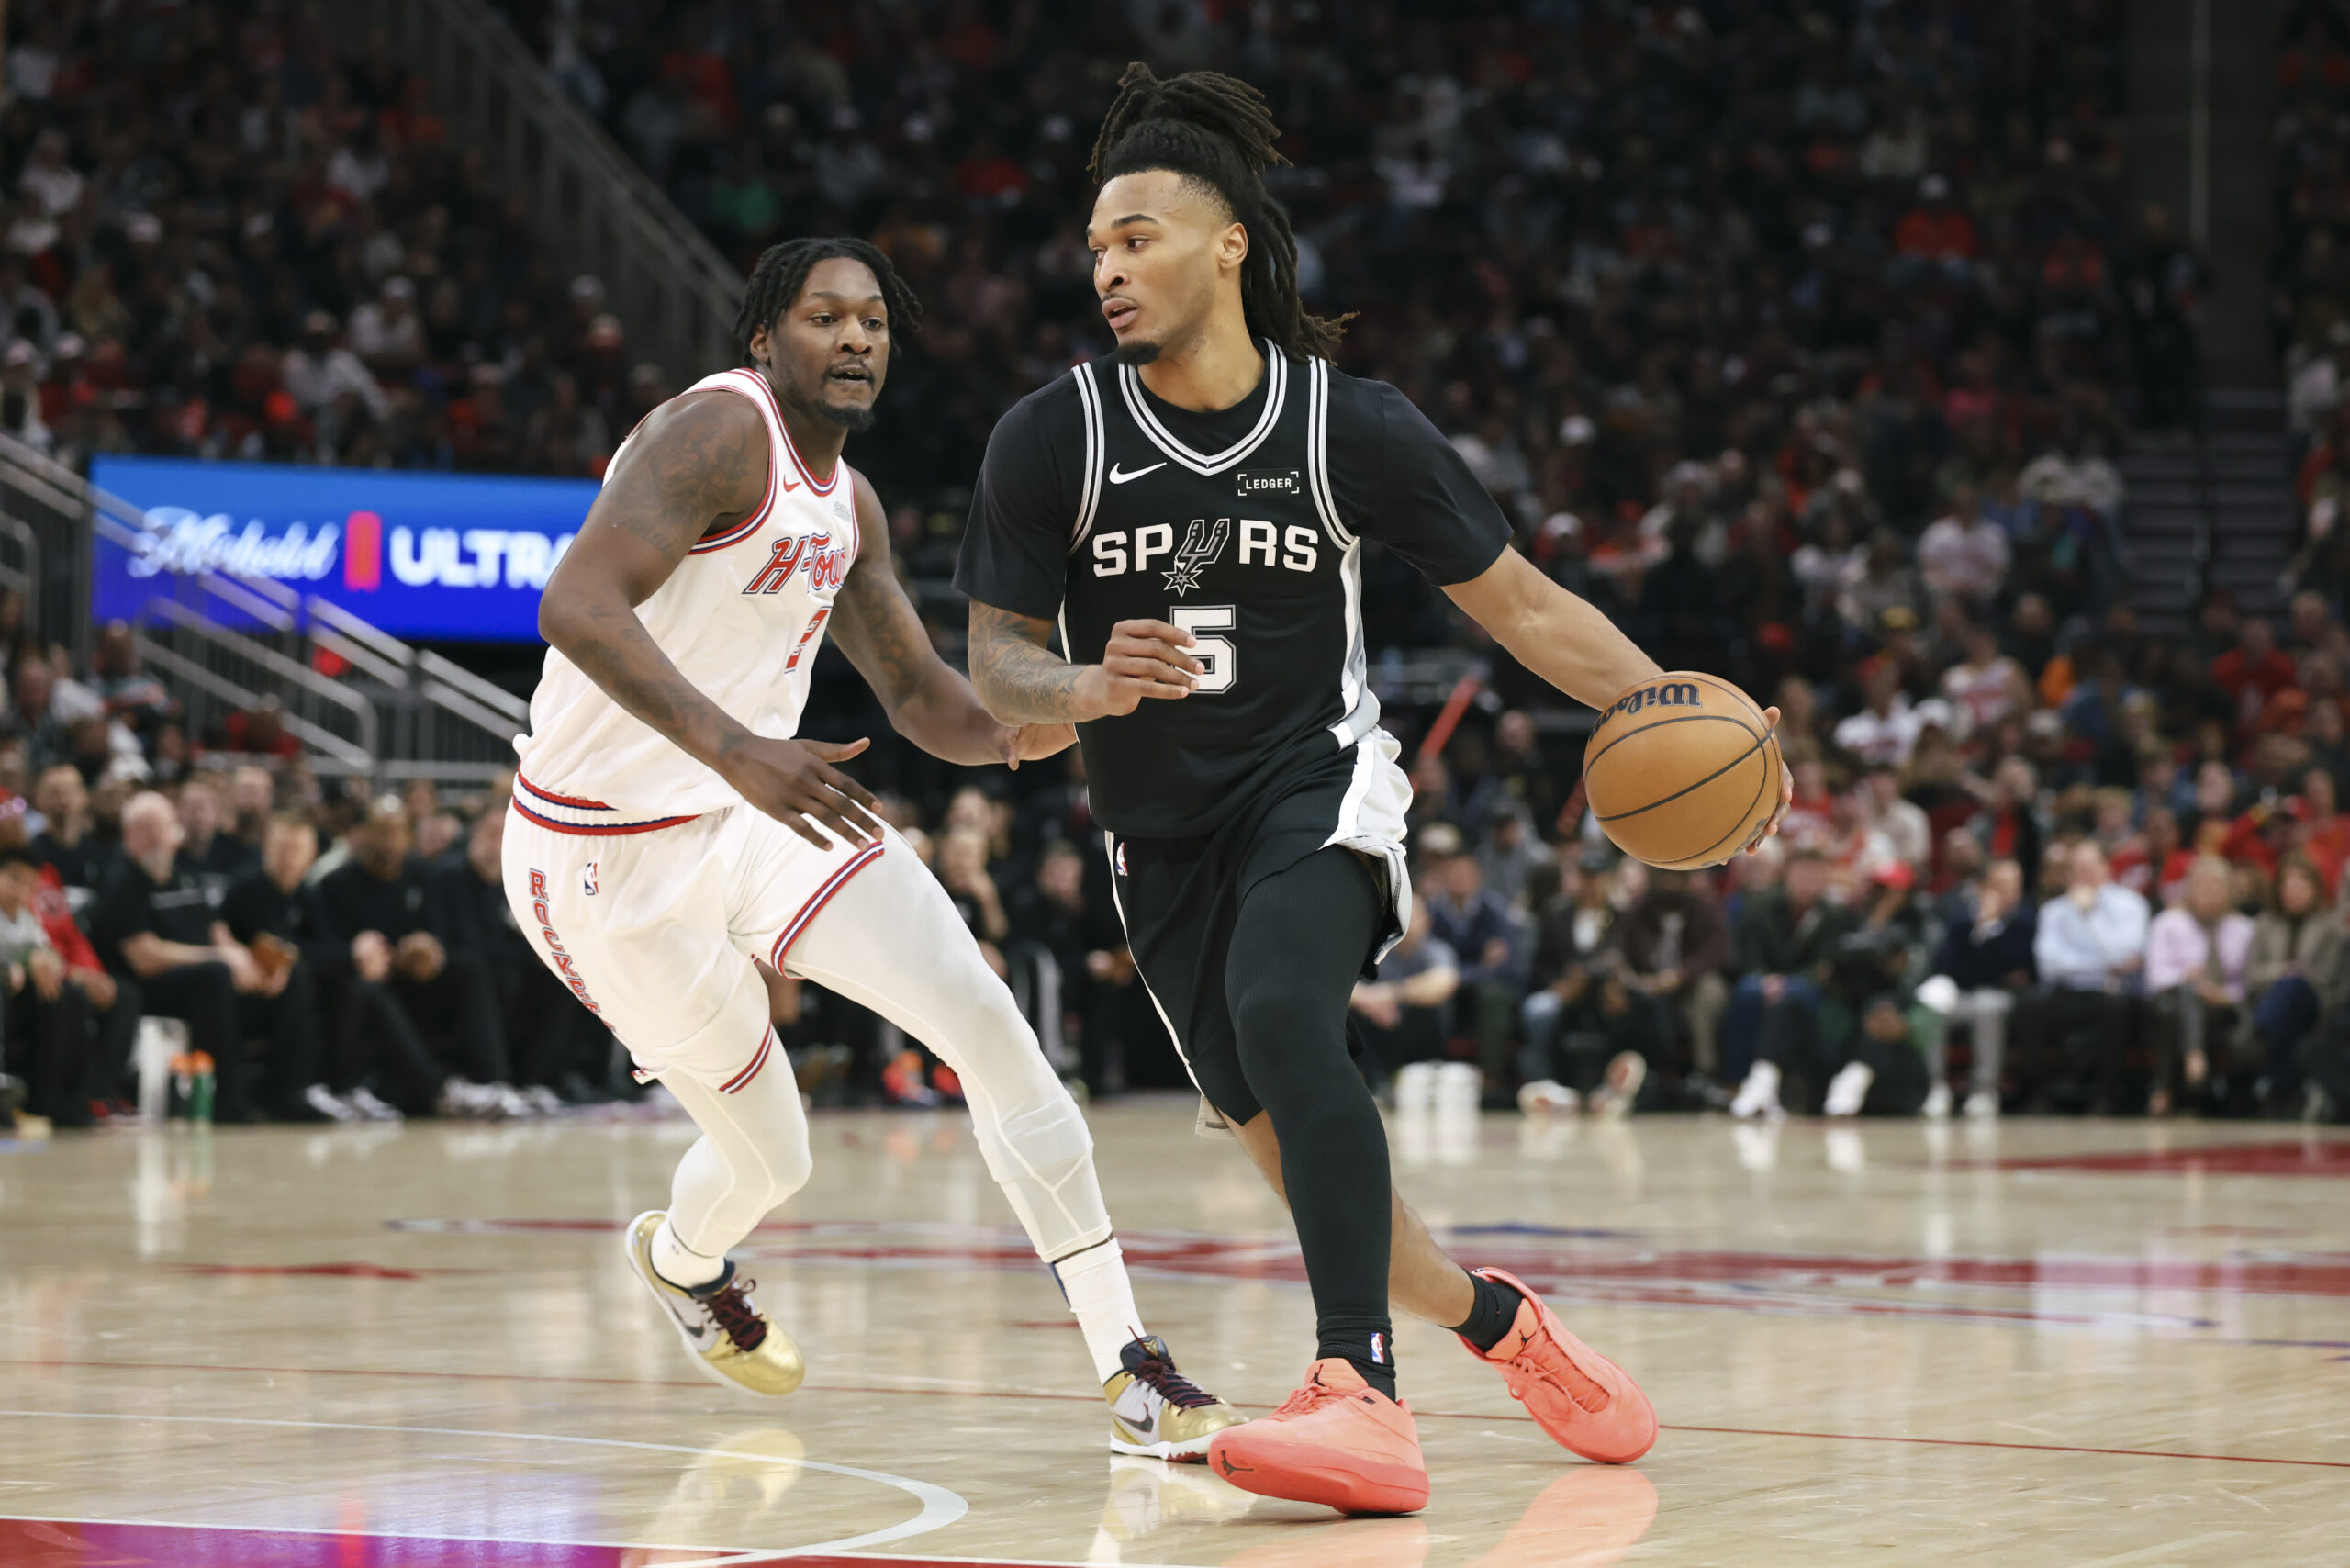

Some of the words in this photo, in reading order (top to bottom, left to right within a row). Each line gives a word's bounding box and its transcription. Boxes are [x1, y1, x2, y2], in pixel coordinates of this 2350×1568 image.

[1245, 477, 1292, 490] LEDGER
[1092, 518, 1319, 598] SPURS
[1169, 604, 1237, 694] 5
